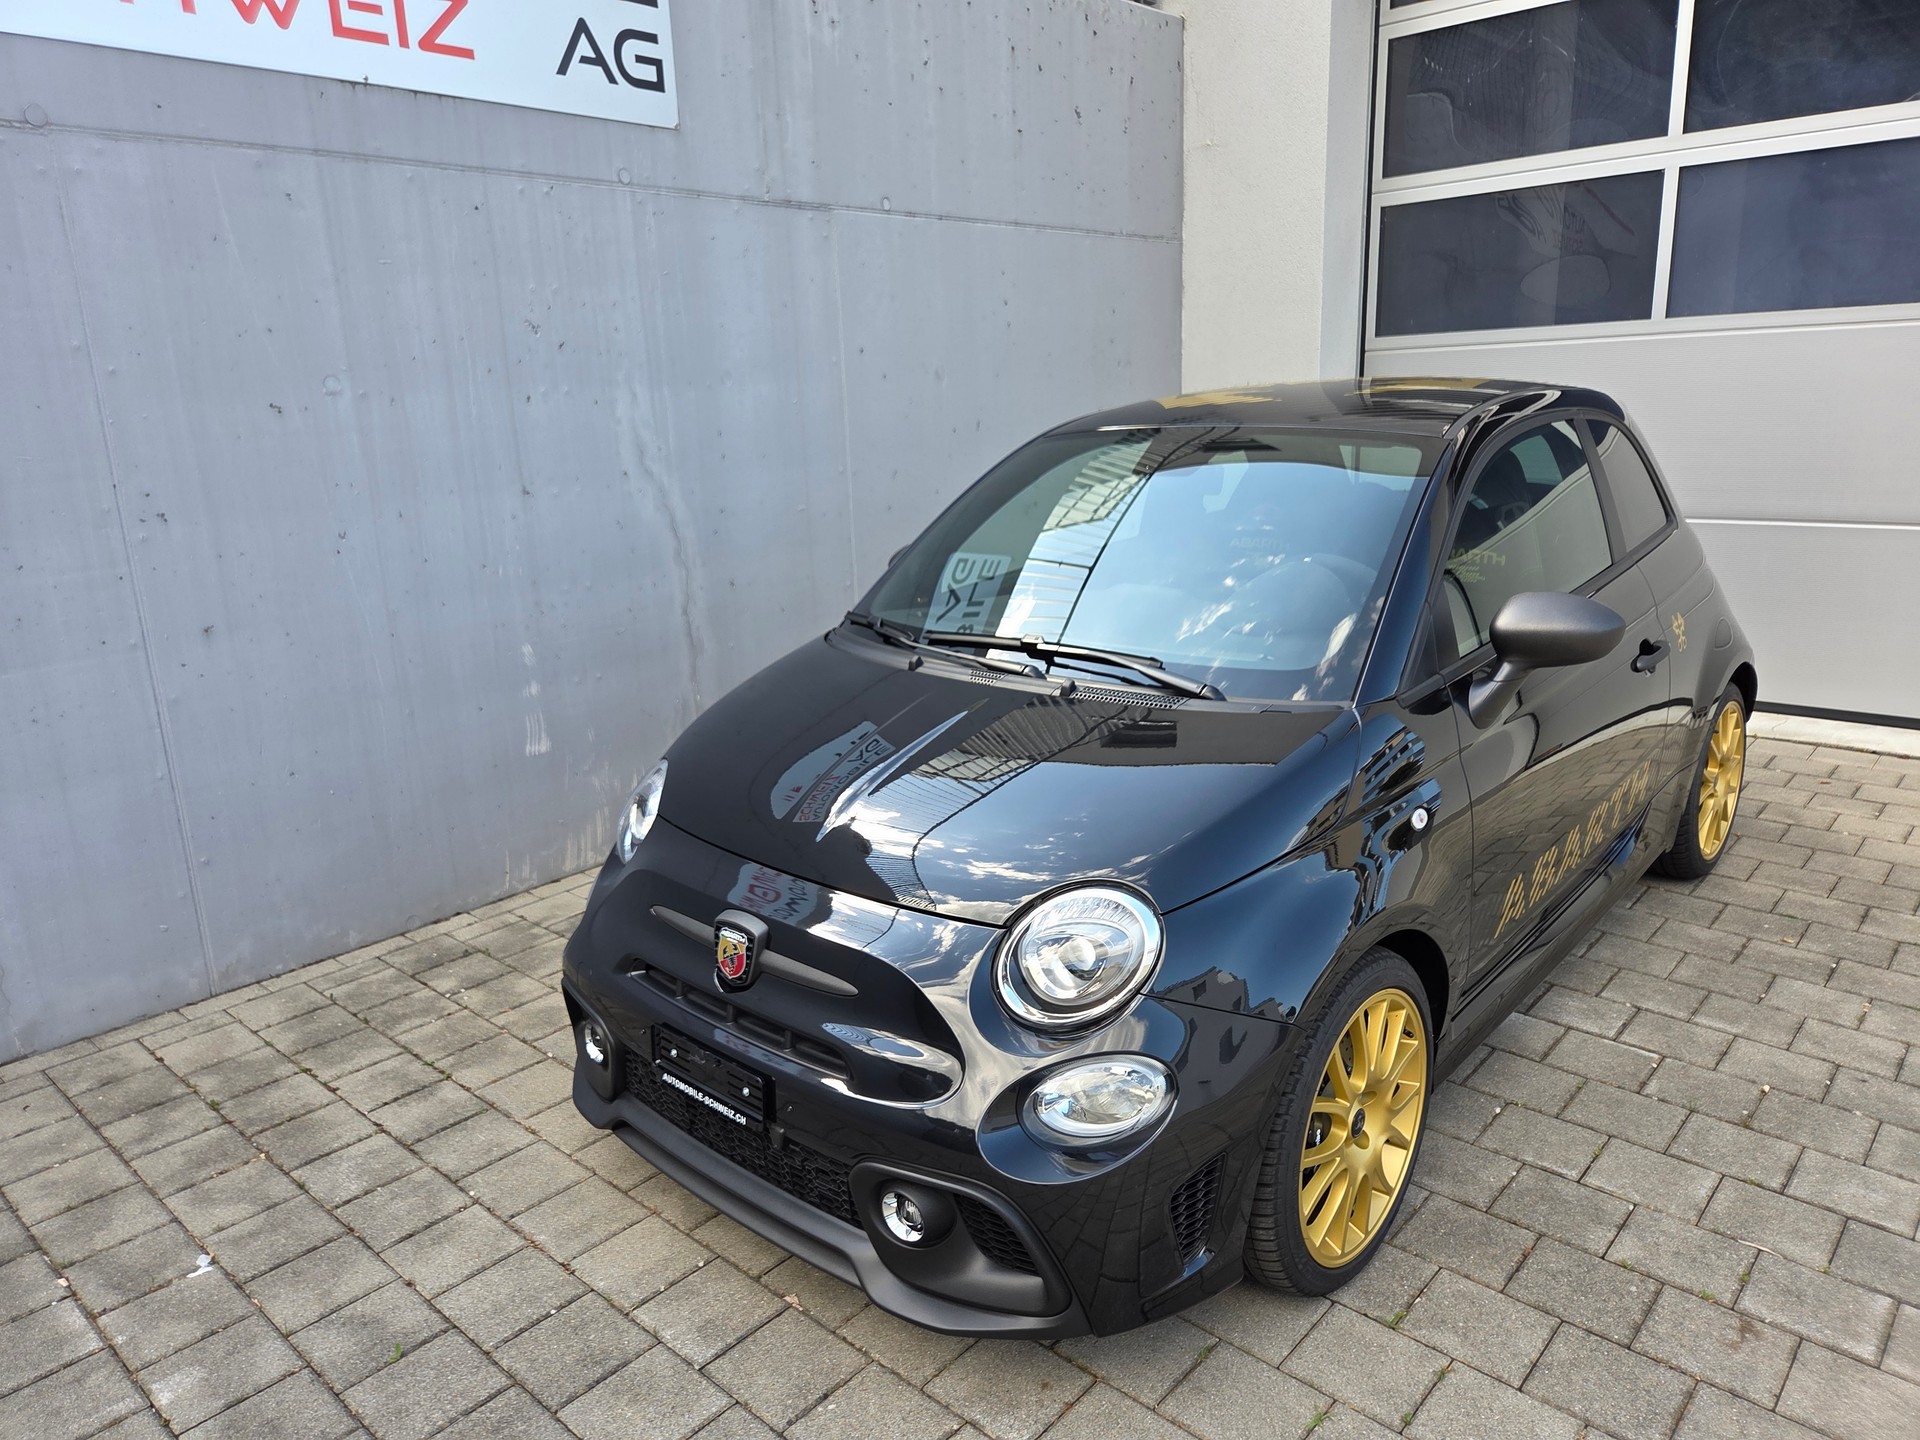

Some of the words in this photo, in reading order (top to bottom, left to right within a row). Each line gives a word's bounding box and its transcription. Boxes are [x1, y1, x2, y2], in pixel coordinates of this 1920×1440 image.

[556, 17, 665, 93] AG
[1494, 759, 1651, 939] ABARTH
[662, 1072, 747, 1126] AUTOMOBILE-SCHWEIZ.CH
